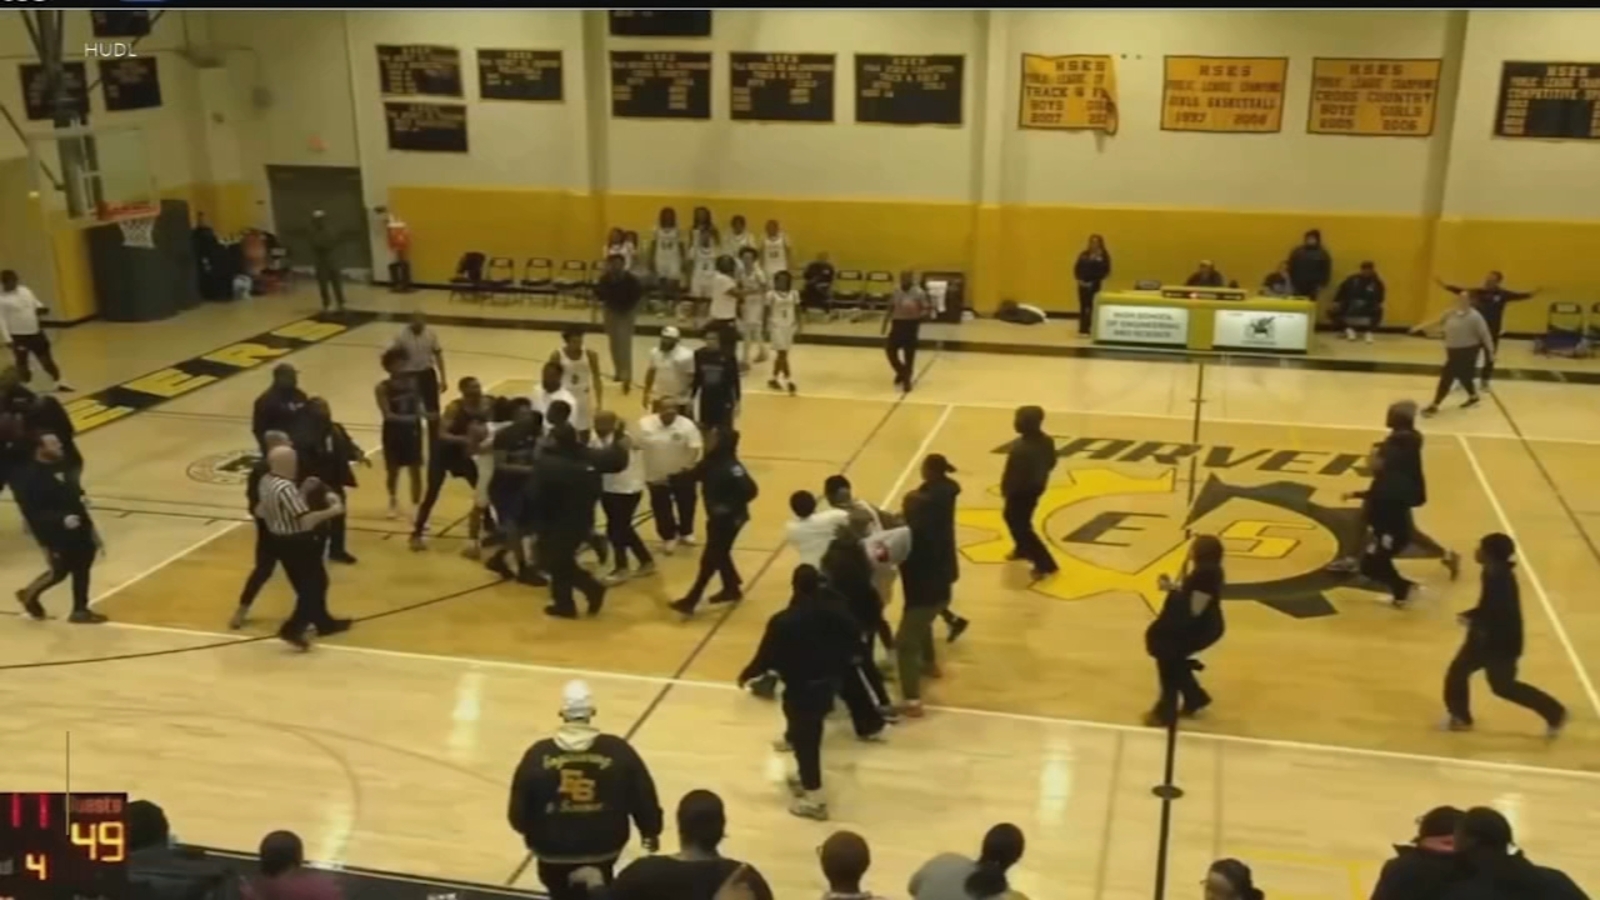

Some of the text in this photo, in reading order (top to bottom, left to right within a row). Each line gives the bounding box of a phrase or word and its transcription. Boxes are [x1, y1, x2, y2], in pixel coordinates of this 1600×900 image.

[1026, 86, 1068, 98] TRACK
[1315, 90, 1433, 105] CROSS COUNTRY
[1030, 99, 1064, 111] BOYS
[1207, 97, 1277, 110] BASKETBALL
[1320, 103, 1423, 118] BOYS GIRLS
[70, 821, 125, 863] 49
[25, 853, 46, 881] 4
